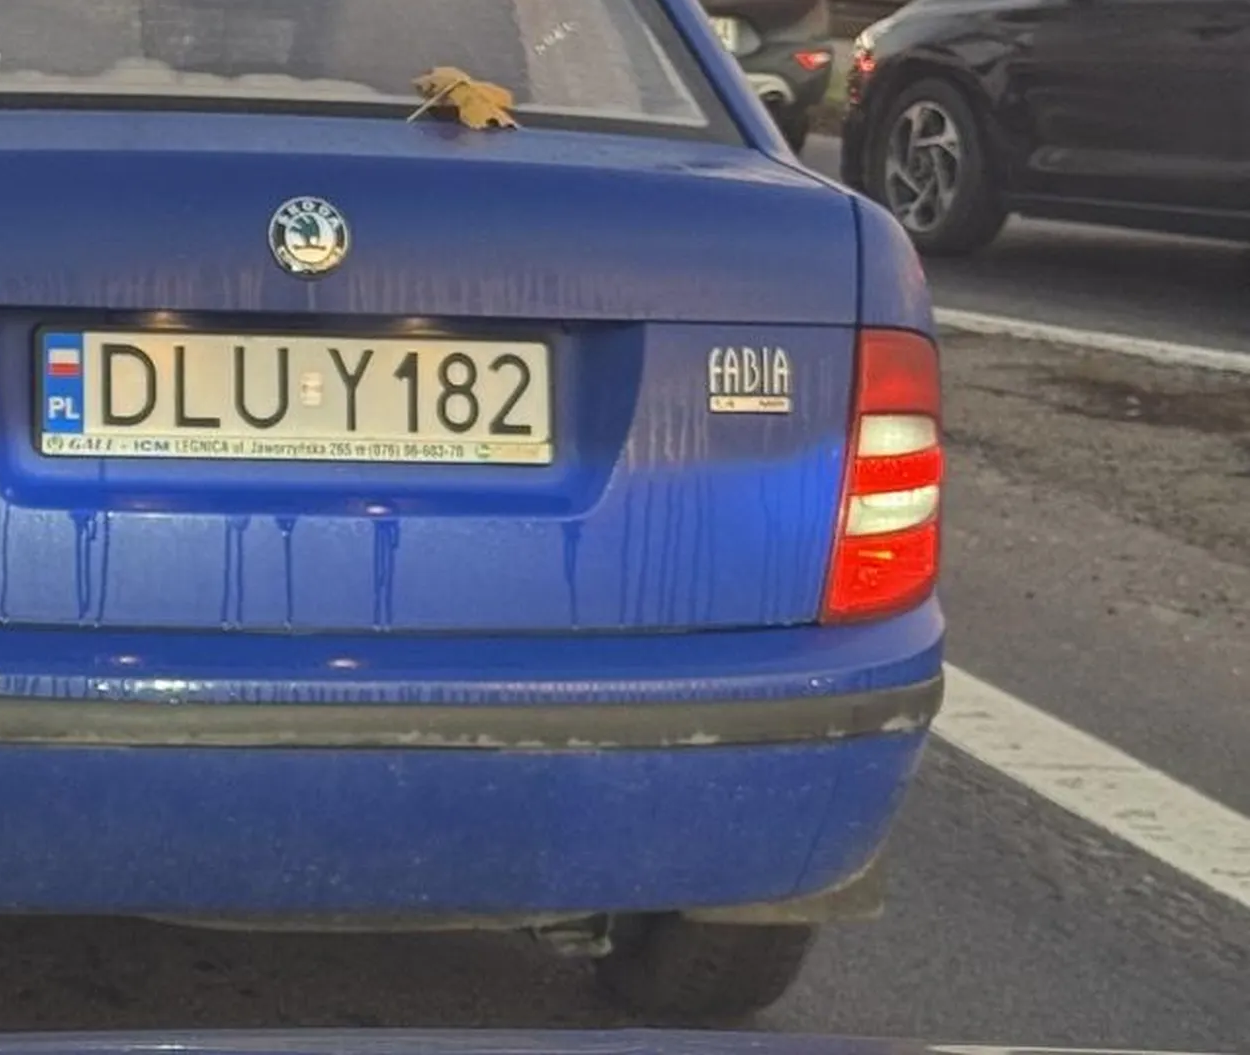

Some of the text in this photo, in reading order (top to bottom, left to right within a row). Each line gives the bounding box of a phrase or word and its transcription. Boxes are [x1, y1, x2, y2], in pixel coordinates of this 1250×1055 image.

[709, 346, 789, 394] FABIA
[48, 395, 80, 421] PL
[100, 344, 533, 435] DLU Y182
[174, 439, 228, 454] LEGNICA
